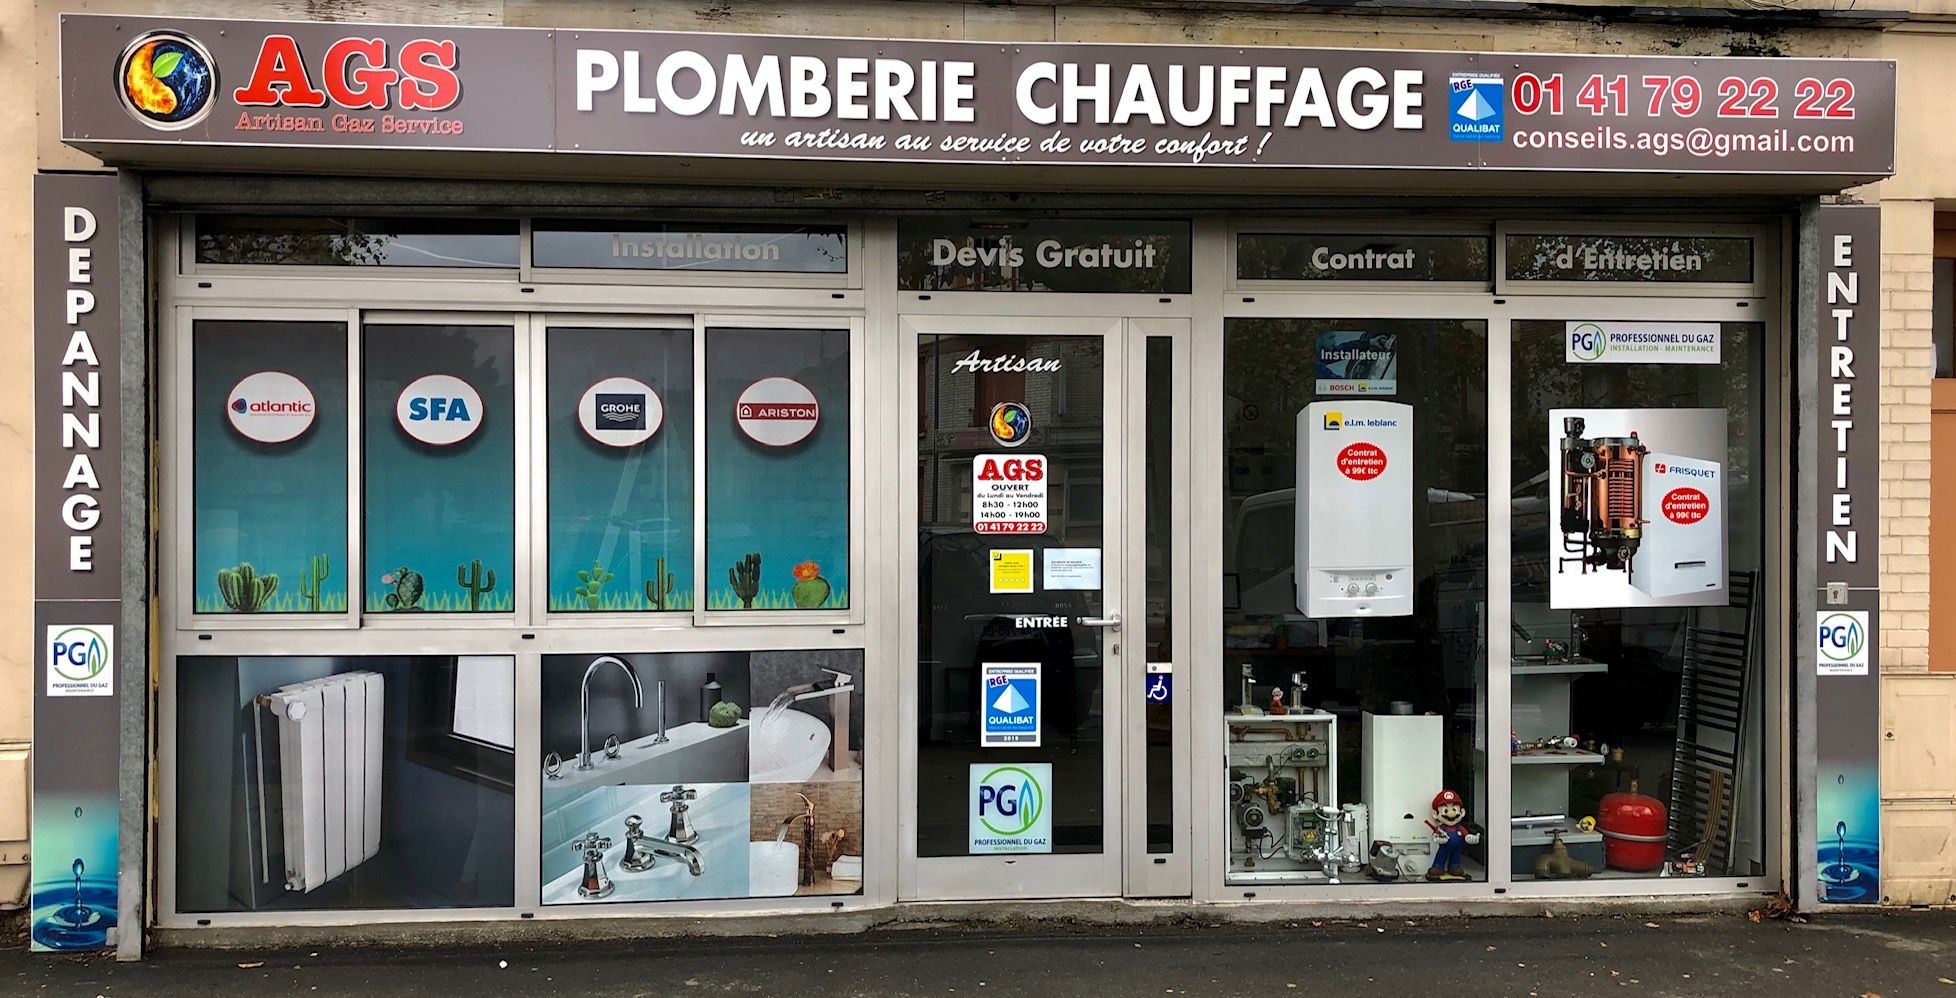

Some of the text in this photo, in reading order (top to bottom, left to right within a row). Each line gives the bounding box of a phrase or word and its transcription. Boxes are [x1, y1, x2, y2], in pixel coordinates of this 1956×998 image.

[233, 35, 462, 111] AGS
[576, 49, 1424, 129] PLOMBERIE CHAUFFAGE
[1453, 79, 1473, 91] RGE
[1511, 73, 1856, 120] 01 41 79 22 22
[235, 111, 465, 136] Artisan Gaz Service
[1453, 123, 1501, 133] QUALIBAT
[740, 128, 1273, 163] un artisan au service de votre confort !
[1512, 126, 1855, 156] conseils.ags@gmail.com
[612, 233, 780, 261] Installation
[933, 237, 1157, 269] Devis Gratuit
[1311, 244, 1702, 271] Contrat d'Entretien
[1610, 333, 1715, 344] PROFESSIONNEL DU GAZ
[1320, 348, 1391, 361] Installateur
[1610, 344, 1659, 352] INSTALLATION
[1664, 345, 1714, 353] MAINTENANCE
[951, 349, 1062, 374] Artisan
[61, 206, 101, 572] DEPANNAGE
[1329, 384, 1355, 392] BOSCH
[1826, 235, 1859, 563] ENTRETIEN
[249, 400, 312, 413] atlantic
[409, 397, 471, 421] SFA
[600, 403, 641, 413] GROHE
[758, 408, 816, 417] ARISTON
[1344, 419, 1398, 427] e.l.m. leblanc
[1347, 448, 1378, 457] Contrat
[1340, 457, 1384, 466] d'entretien
[977, 459, 1044, 481] AGS
[1352, 467, 1366, 475] 99€
[1368, 467, 1379, 475] ttc
[1669, 466, 1716, 478] FRISQUET
[1671, 493, 1701, 501] Contrat
[1664, 502, 1706, 510] d'entretien
[980, 511, 1006, 519] 14h00
[1015, 511, 1041, 519] 19h00
[1676, 511, 1690, 519] 99€
[1691, 511, 1702, 519] ttc
[977, 522, 1044, 531] 01 41 79 22 22
[1015, 616, 1068, 628] ENTRÉE
[989, 675, 1008, 687] RGE
[988, 716, 1034, 725] QUALIBAT
[974, 838, 1022, 846] PROFESSIONNEL
